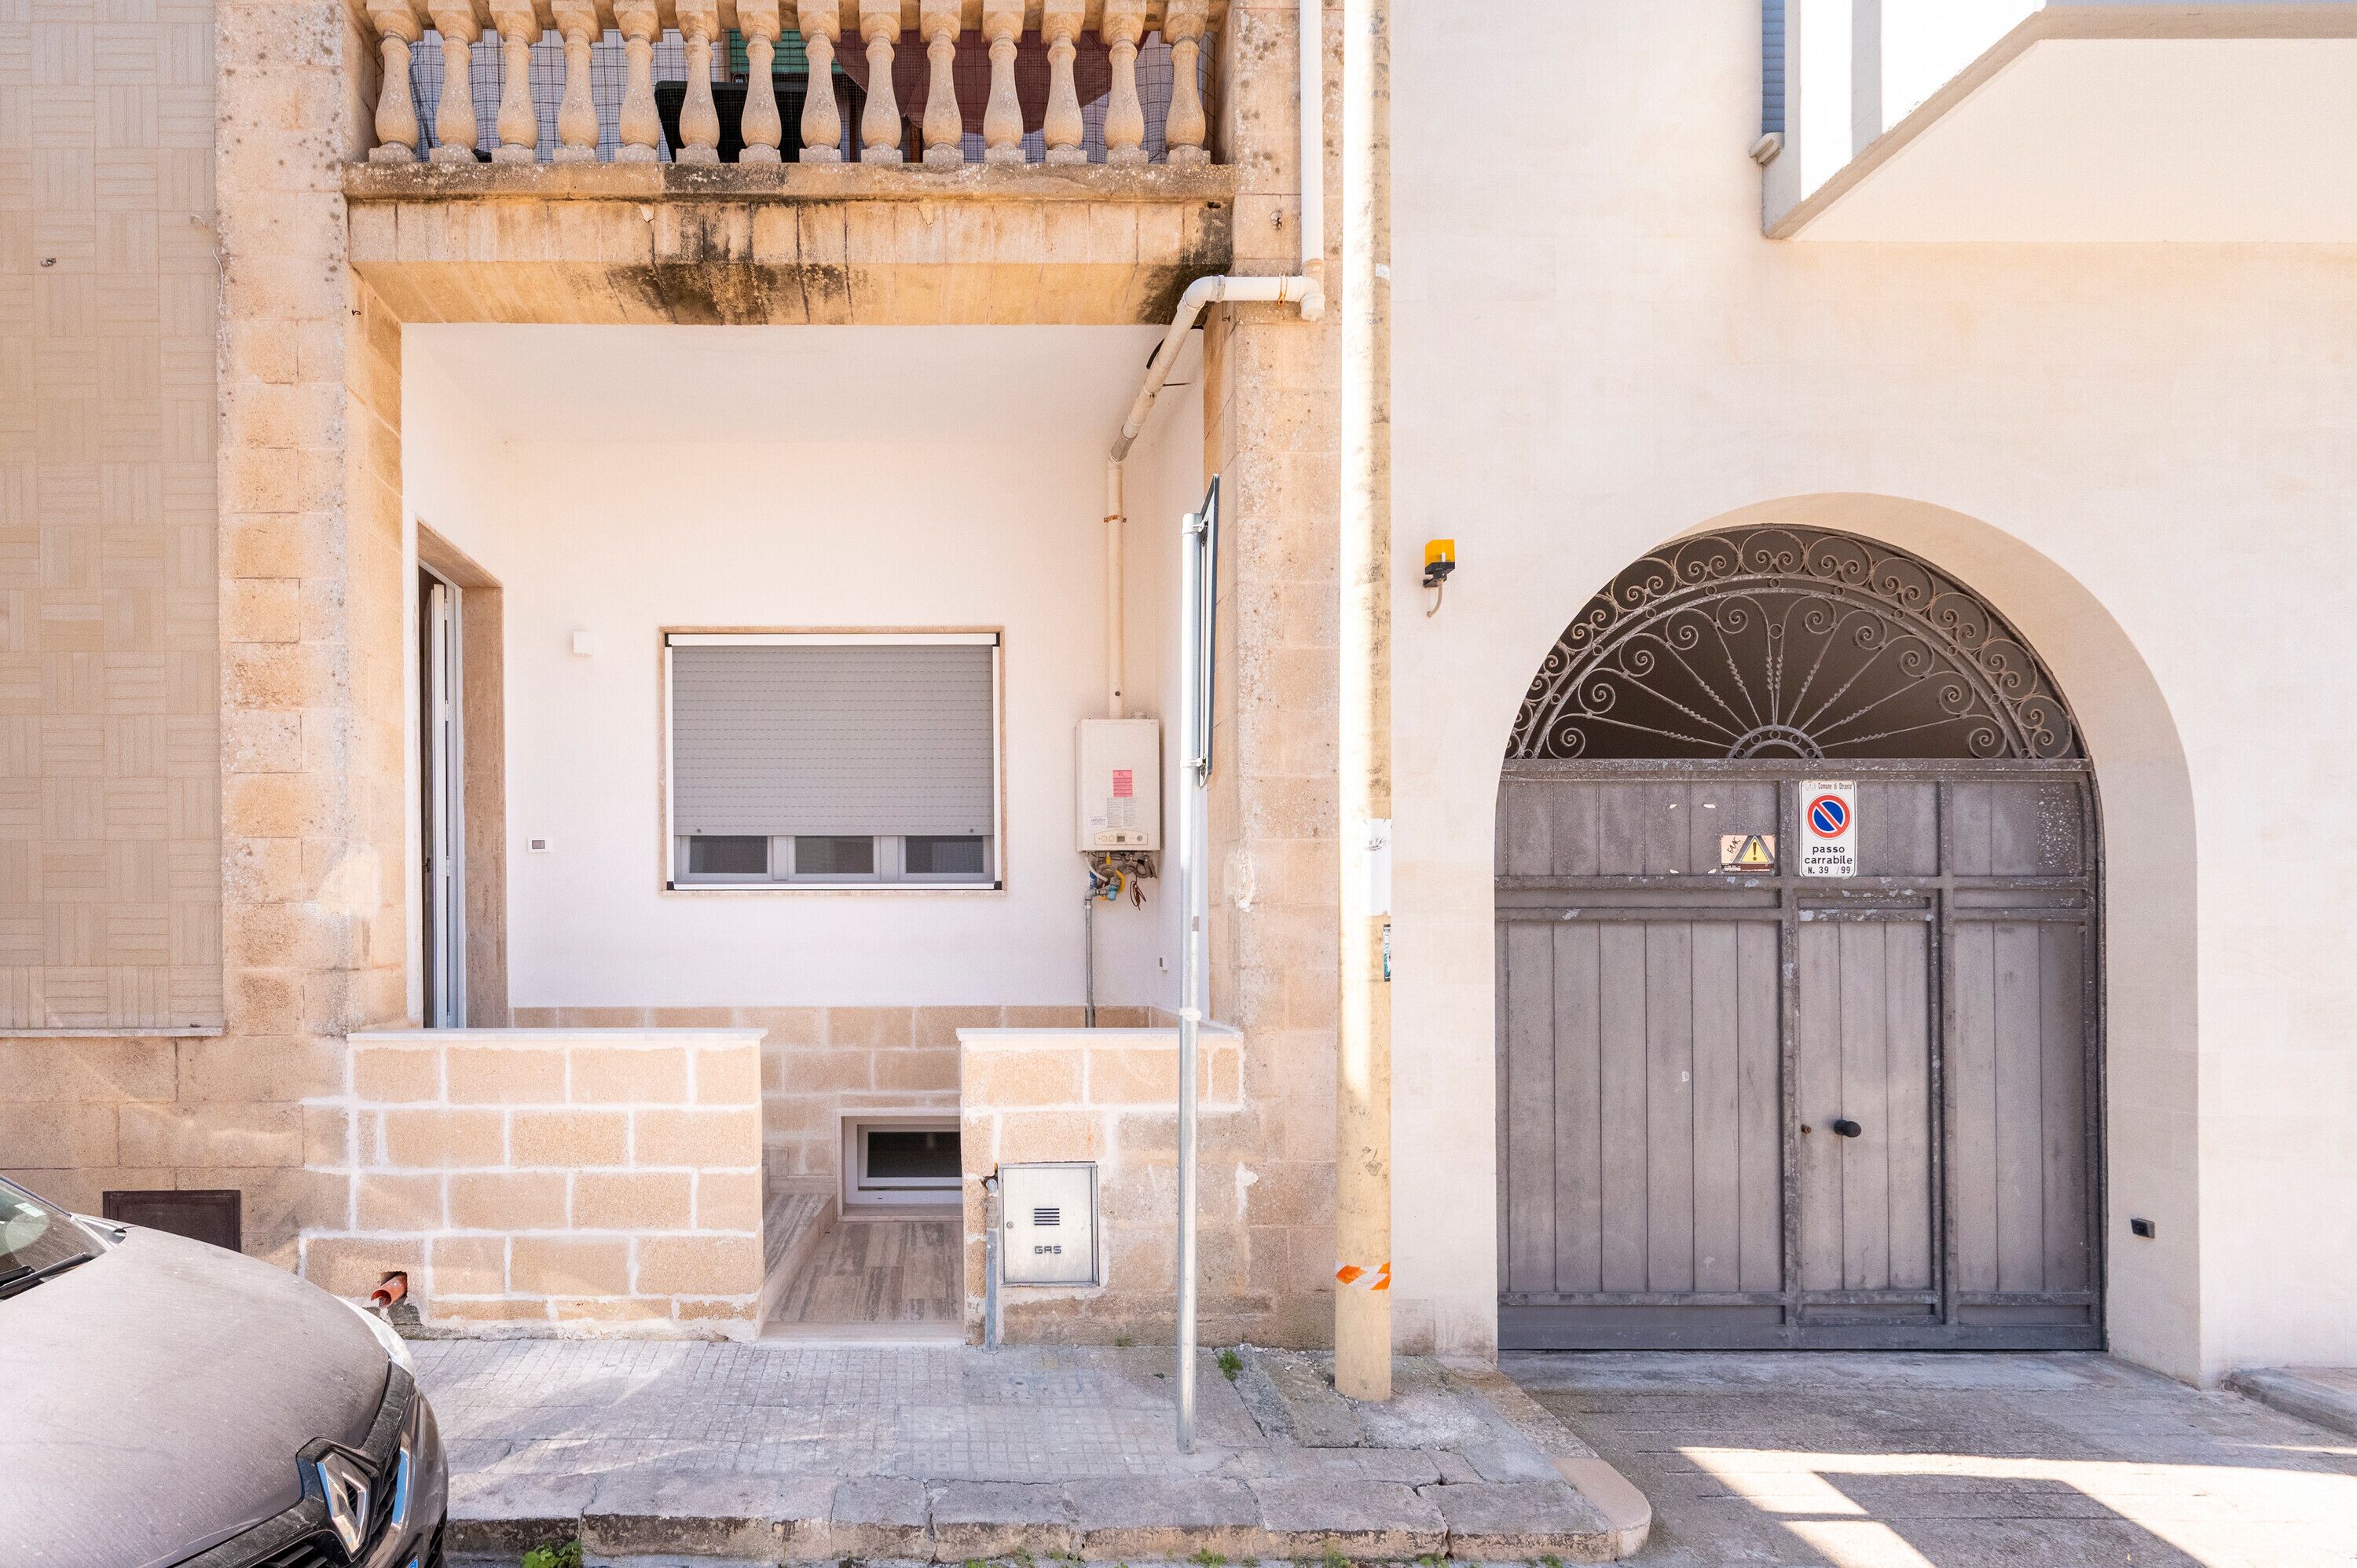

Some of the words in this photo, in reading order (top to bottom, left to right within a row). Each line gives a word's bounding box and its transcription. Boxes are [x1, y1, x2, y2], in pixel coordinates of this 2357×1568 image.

[1727, 837, 1740, 854] FAAC
[1813, 846, 1845, 855] passo
[1804, 855, 1853, 864] carrabile
